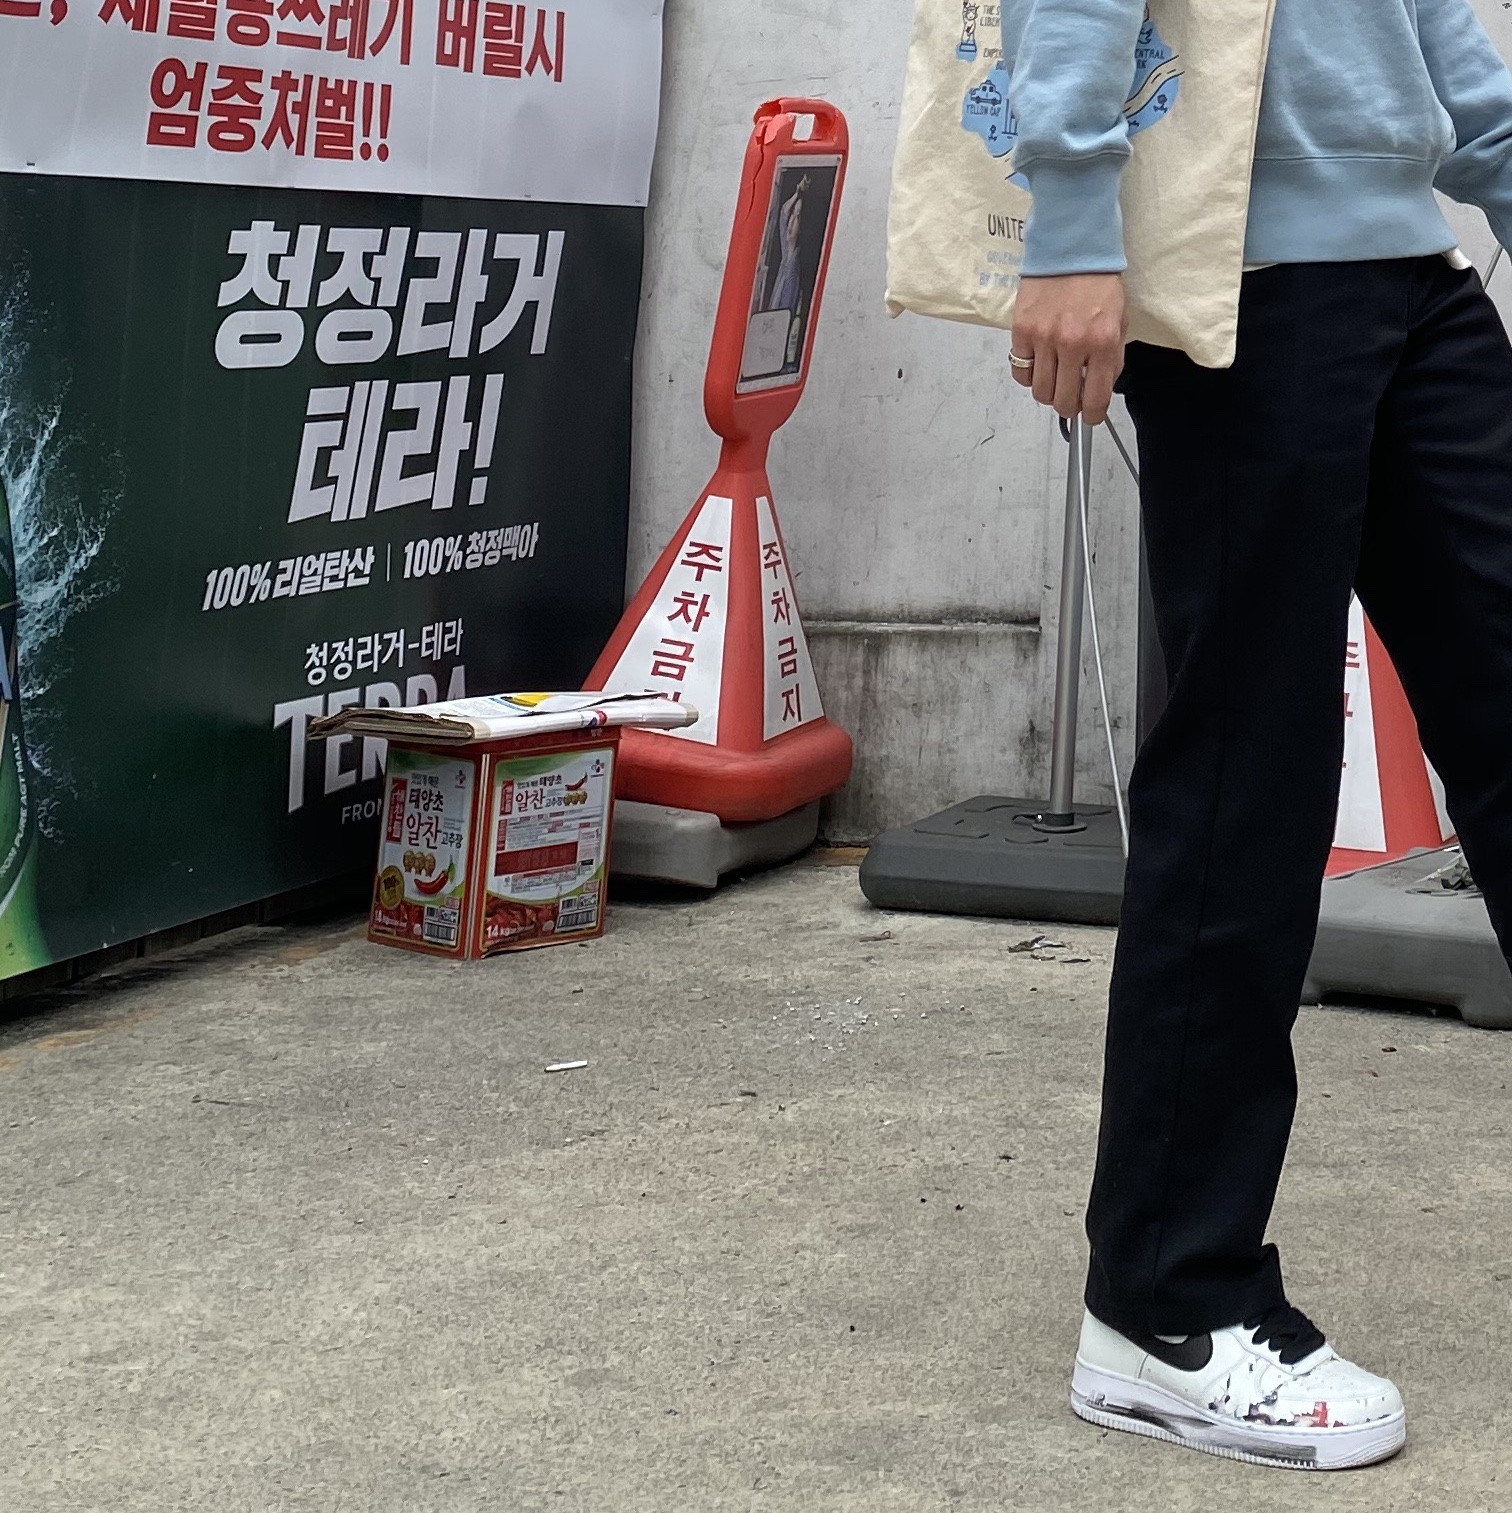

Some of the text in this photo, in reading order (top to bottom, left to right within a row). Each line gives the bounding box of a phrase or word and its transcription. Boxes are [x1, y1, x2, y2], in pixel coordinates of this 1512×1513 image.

[146, 55, 393, 163] 엄중처벌!!
[214, 220, 566, 369] 청정라거
[286, 374, 504, 524] 테라!
[304, 618, 464, 686] 청정라거-테라
[762, 541, 803, 723] 주차금지
[12, 733, 24, 773] MALT
[406, 812, 442, 849] 알찬
[441, 832, 464, 849] 고추장
[409, 788, 444, 813] 태양초
[515, 788, 546, 813] 알찬
